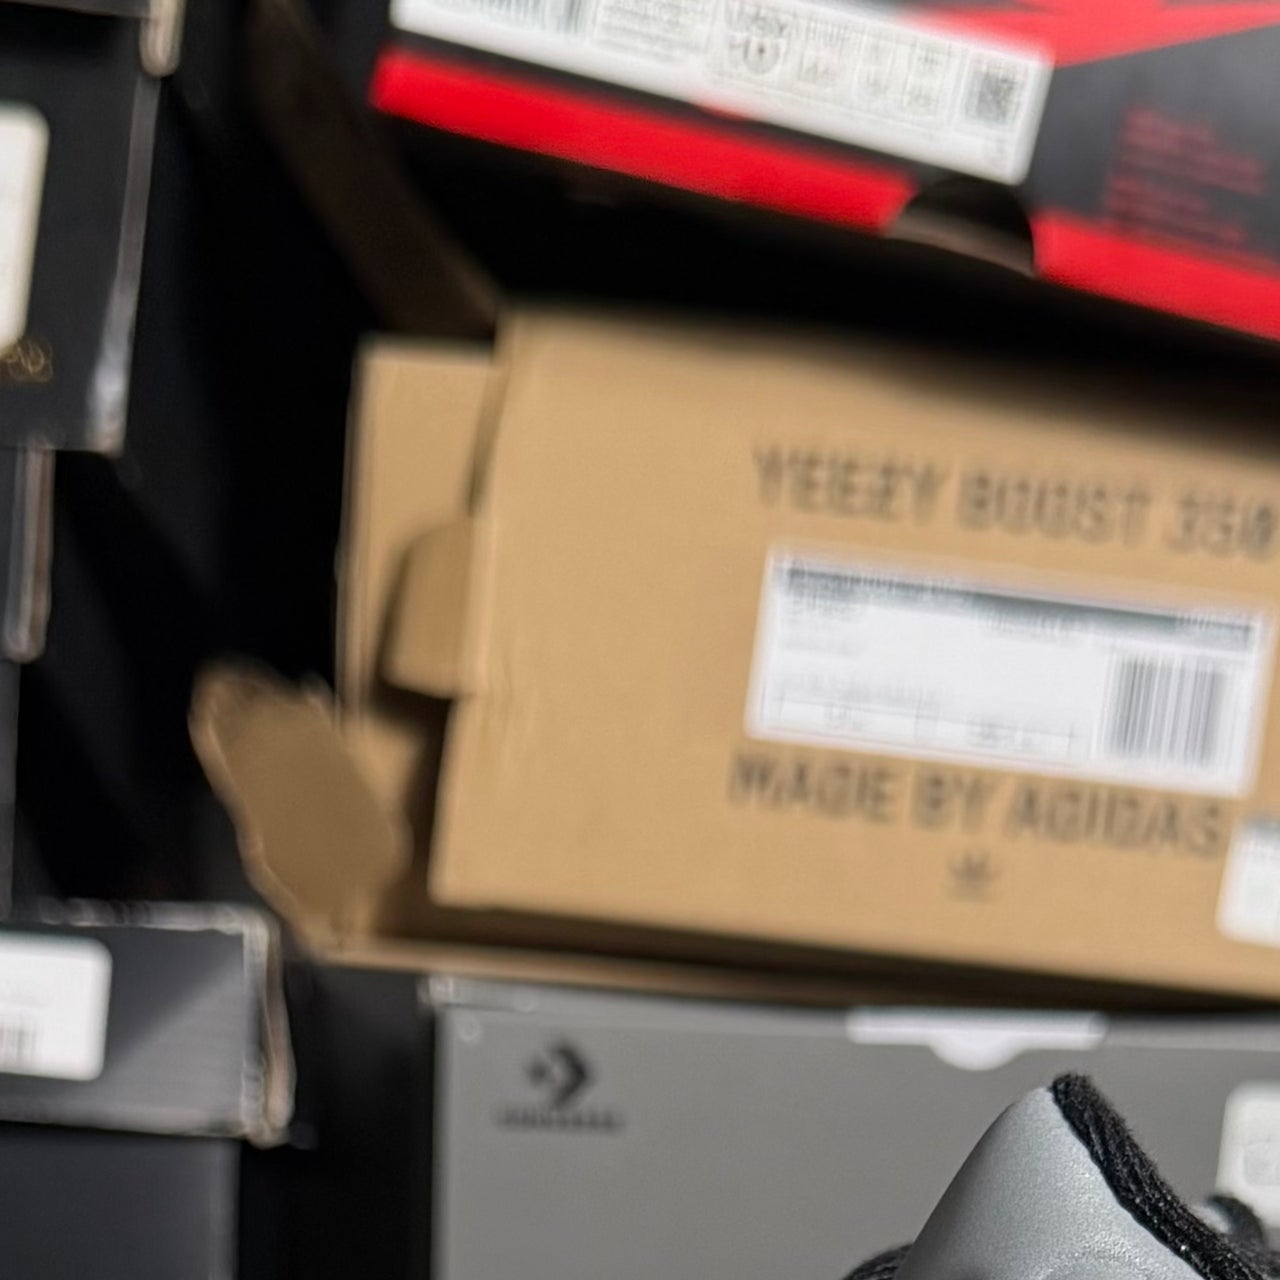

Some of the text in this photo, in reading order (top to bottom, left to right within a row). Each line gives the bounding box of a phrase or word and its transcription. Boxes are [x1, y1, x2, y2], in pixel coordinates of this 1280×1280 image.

[751, 443, 948, 525] YEEZY
[956, 470, 1151, 548] BOOST
[728, 750, 1228, 862] MADE BY ADIDAS
